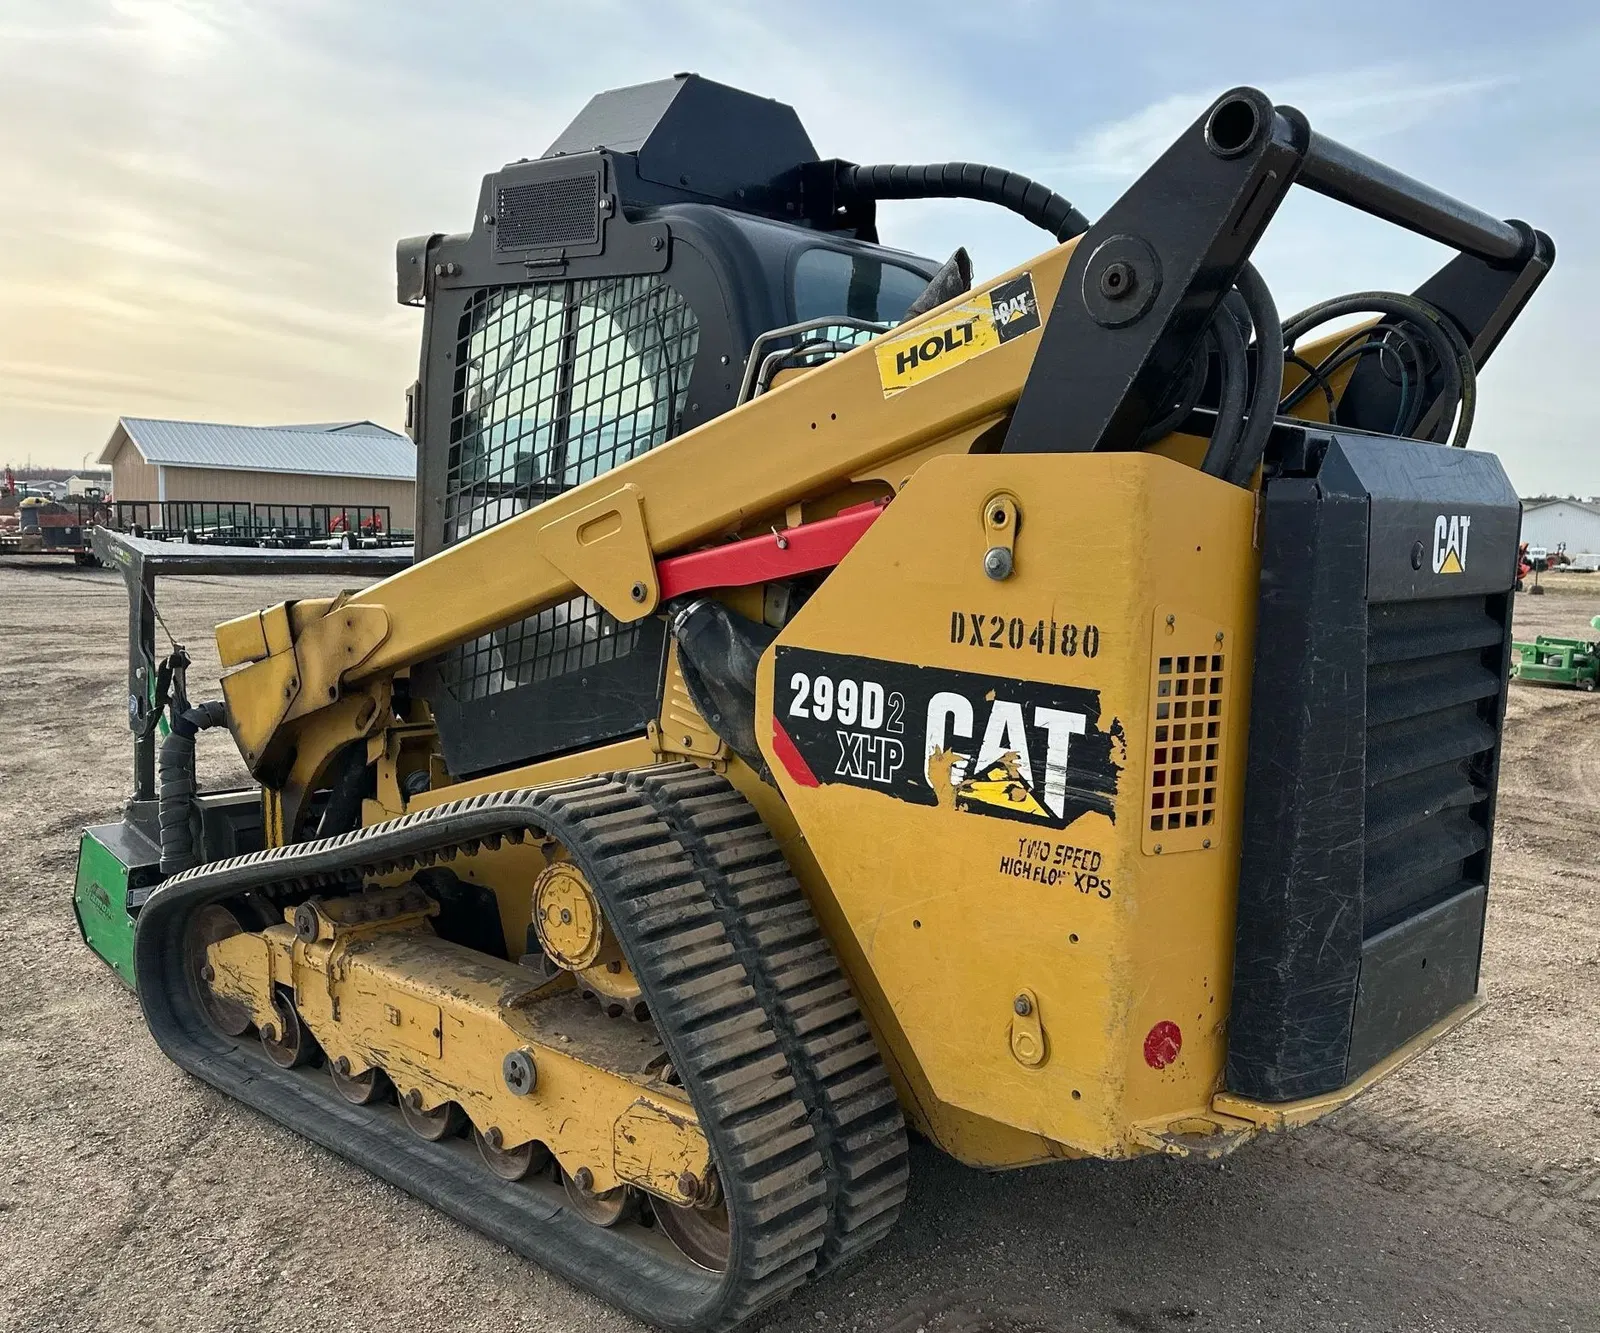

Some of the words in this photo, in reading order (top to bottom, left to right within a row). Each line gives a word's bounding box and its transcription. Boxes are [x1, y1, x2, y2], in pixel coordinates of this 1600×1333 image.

[896, 316, 979, 375] HOLT
[1432, 515, 1470, 574] CAT
[951, 611, 1100, 658] DX204180
[789, 672, 905, 734] 299D2
[834, 731, 904, 784] XHP
[924, 691, 1087, 820] CAT
[999, 856, 1032, 880] HIGH
[1033, 866, 1070, 886] FLO
[1073, 871, 1112, 899] XPS
[1018, 838, 1051, 862] TWO
[1053, 844, 1102, 872] SPEED
